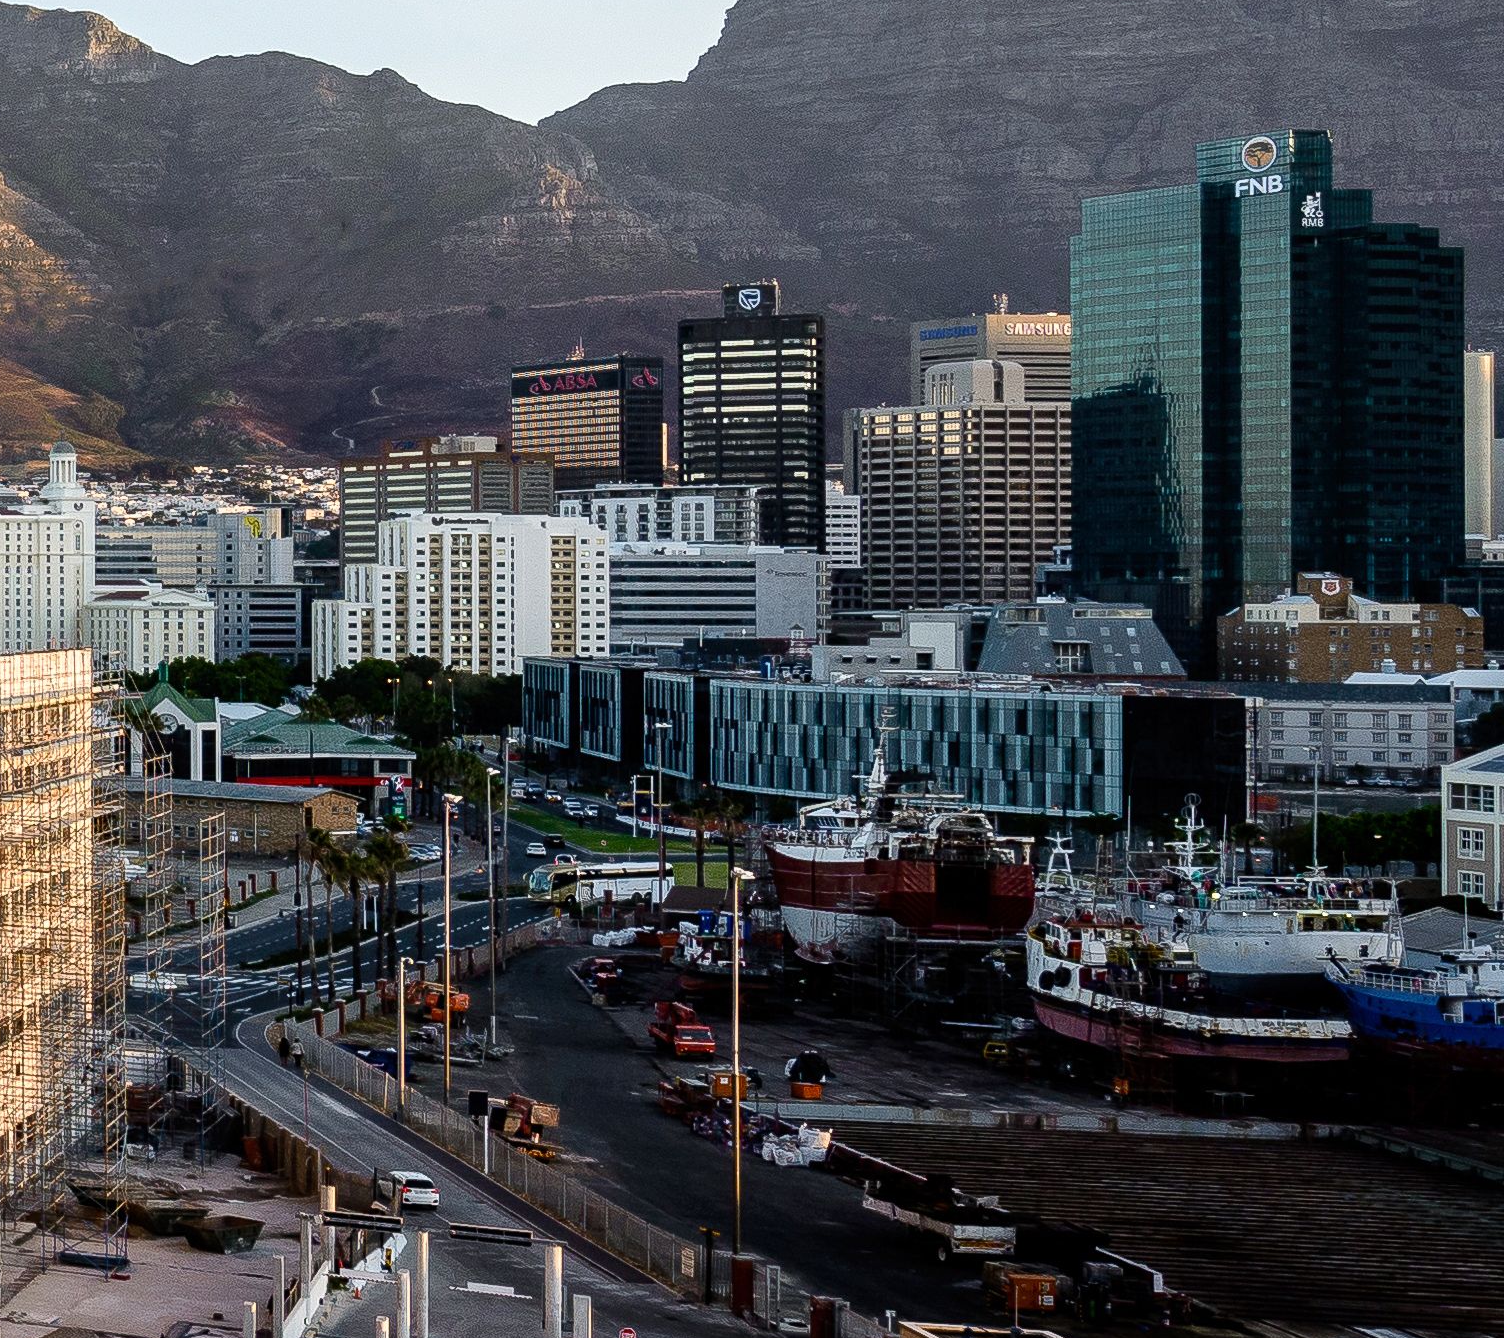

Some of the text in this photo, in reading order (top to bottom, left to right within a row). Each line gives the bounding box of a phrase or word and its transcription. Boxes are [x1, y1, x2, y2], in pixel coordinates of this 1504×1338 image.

[1235, 175, 1283, 197] FNB
[1301, 218, 1324, 228] RMB
[1005, 322, 1072, 336] SAMSUNG
[555, 373, 597, 391] ABSA
